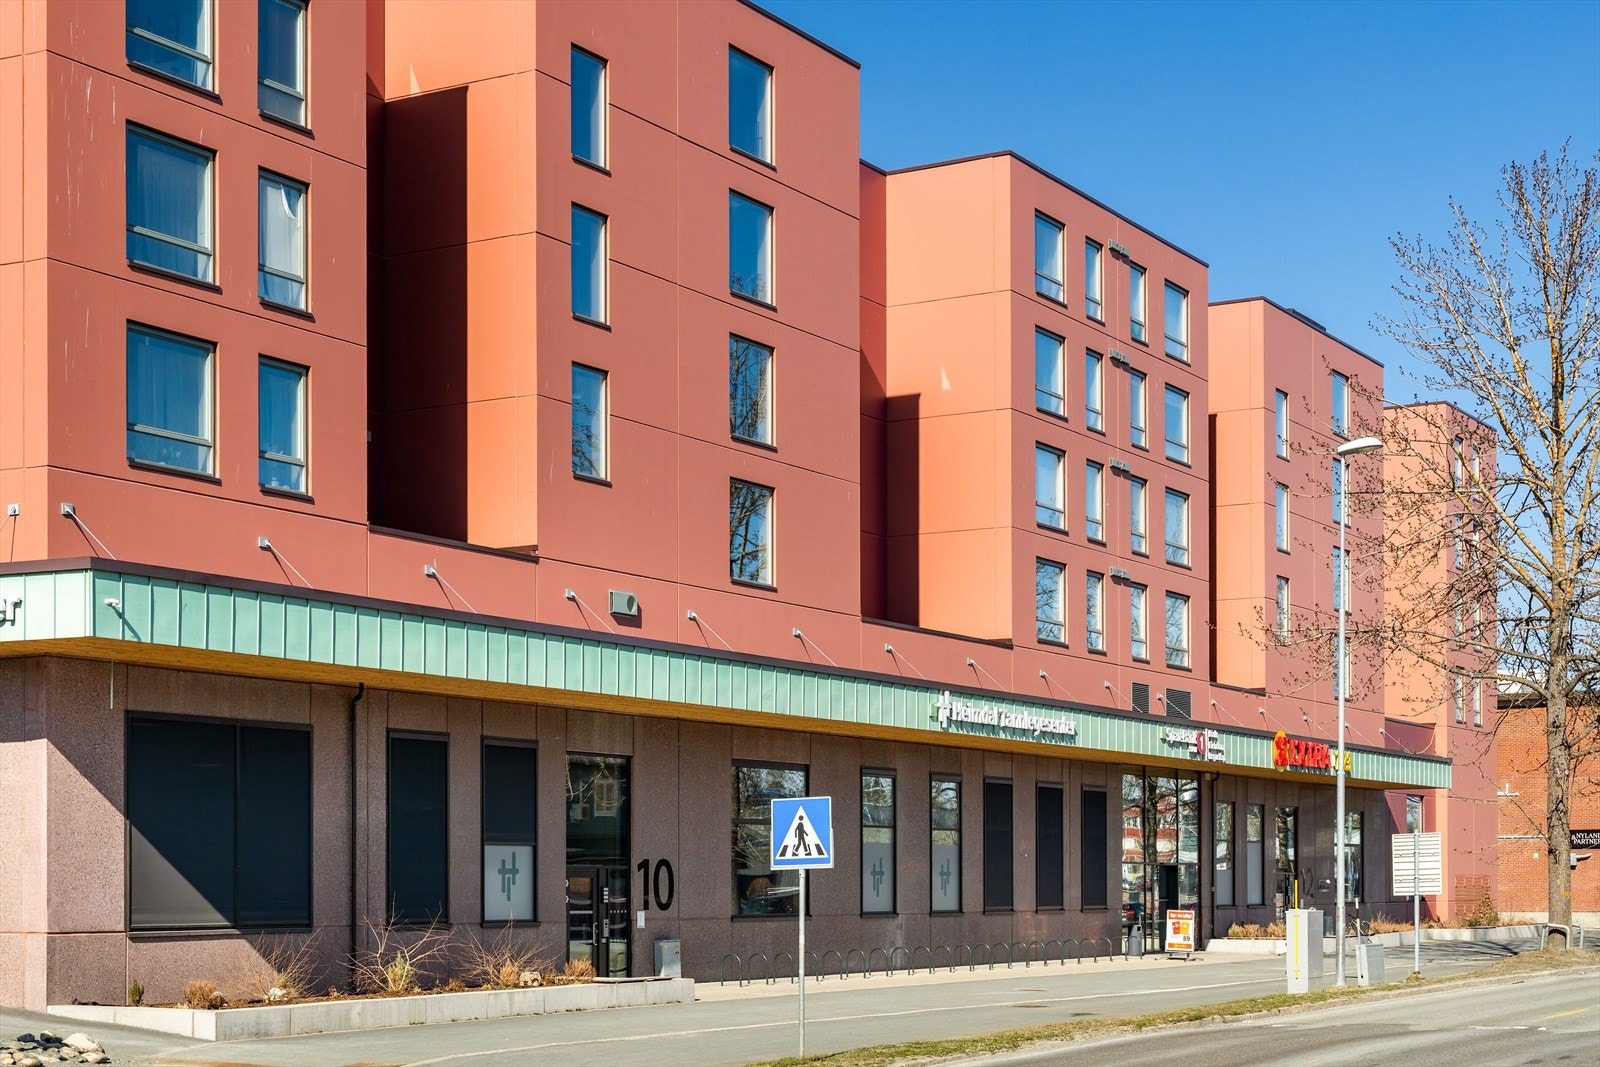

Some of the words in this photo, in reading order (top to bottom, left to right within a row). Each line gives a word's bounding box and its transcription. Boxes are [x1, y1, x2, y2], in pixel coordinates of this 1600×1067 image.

[952, 701, 998, 725] Heimdal
[999, 708, 1076, 735] Tannlegesenter
[637, 859, 674, 911] 10
